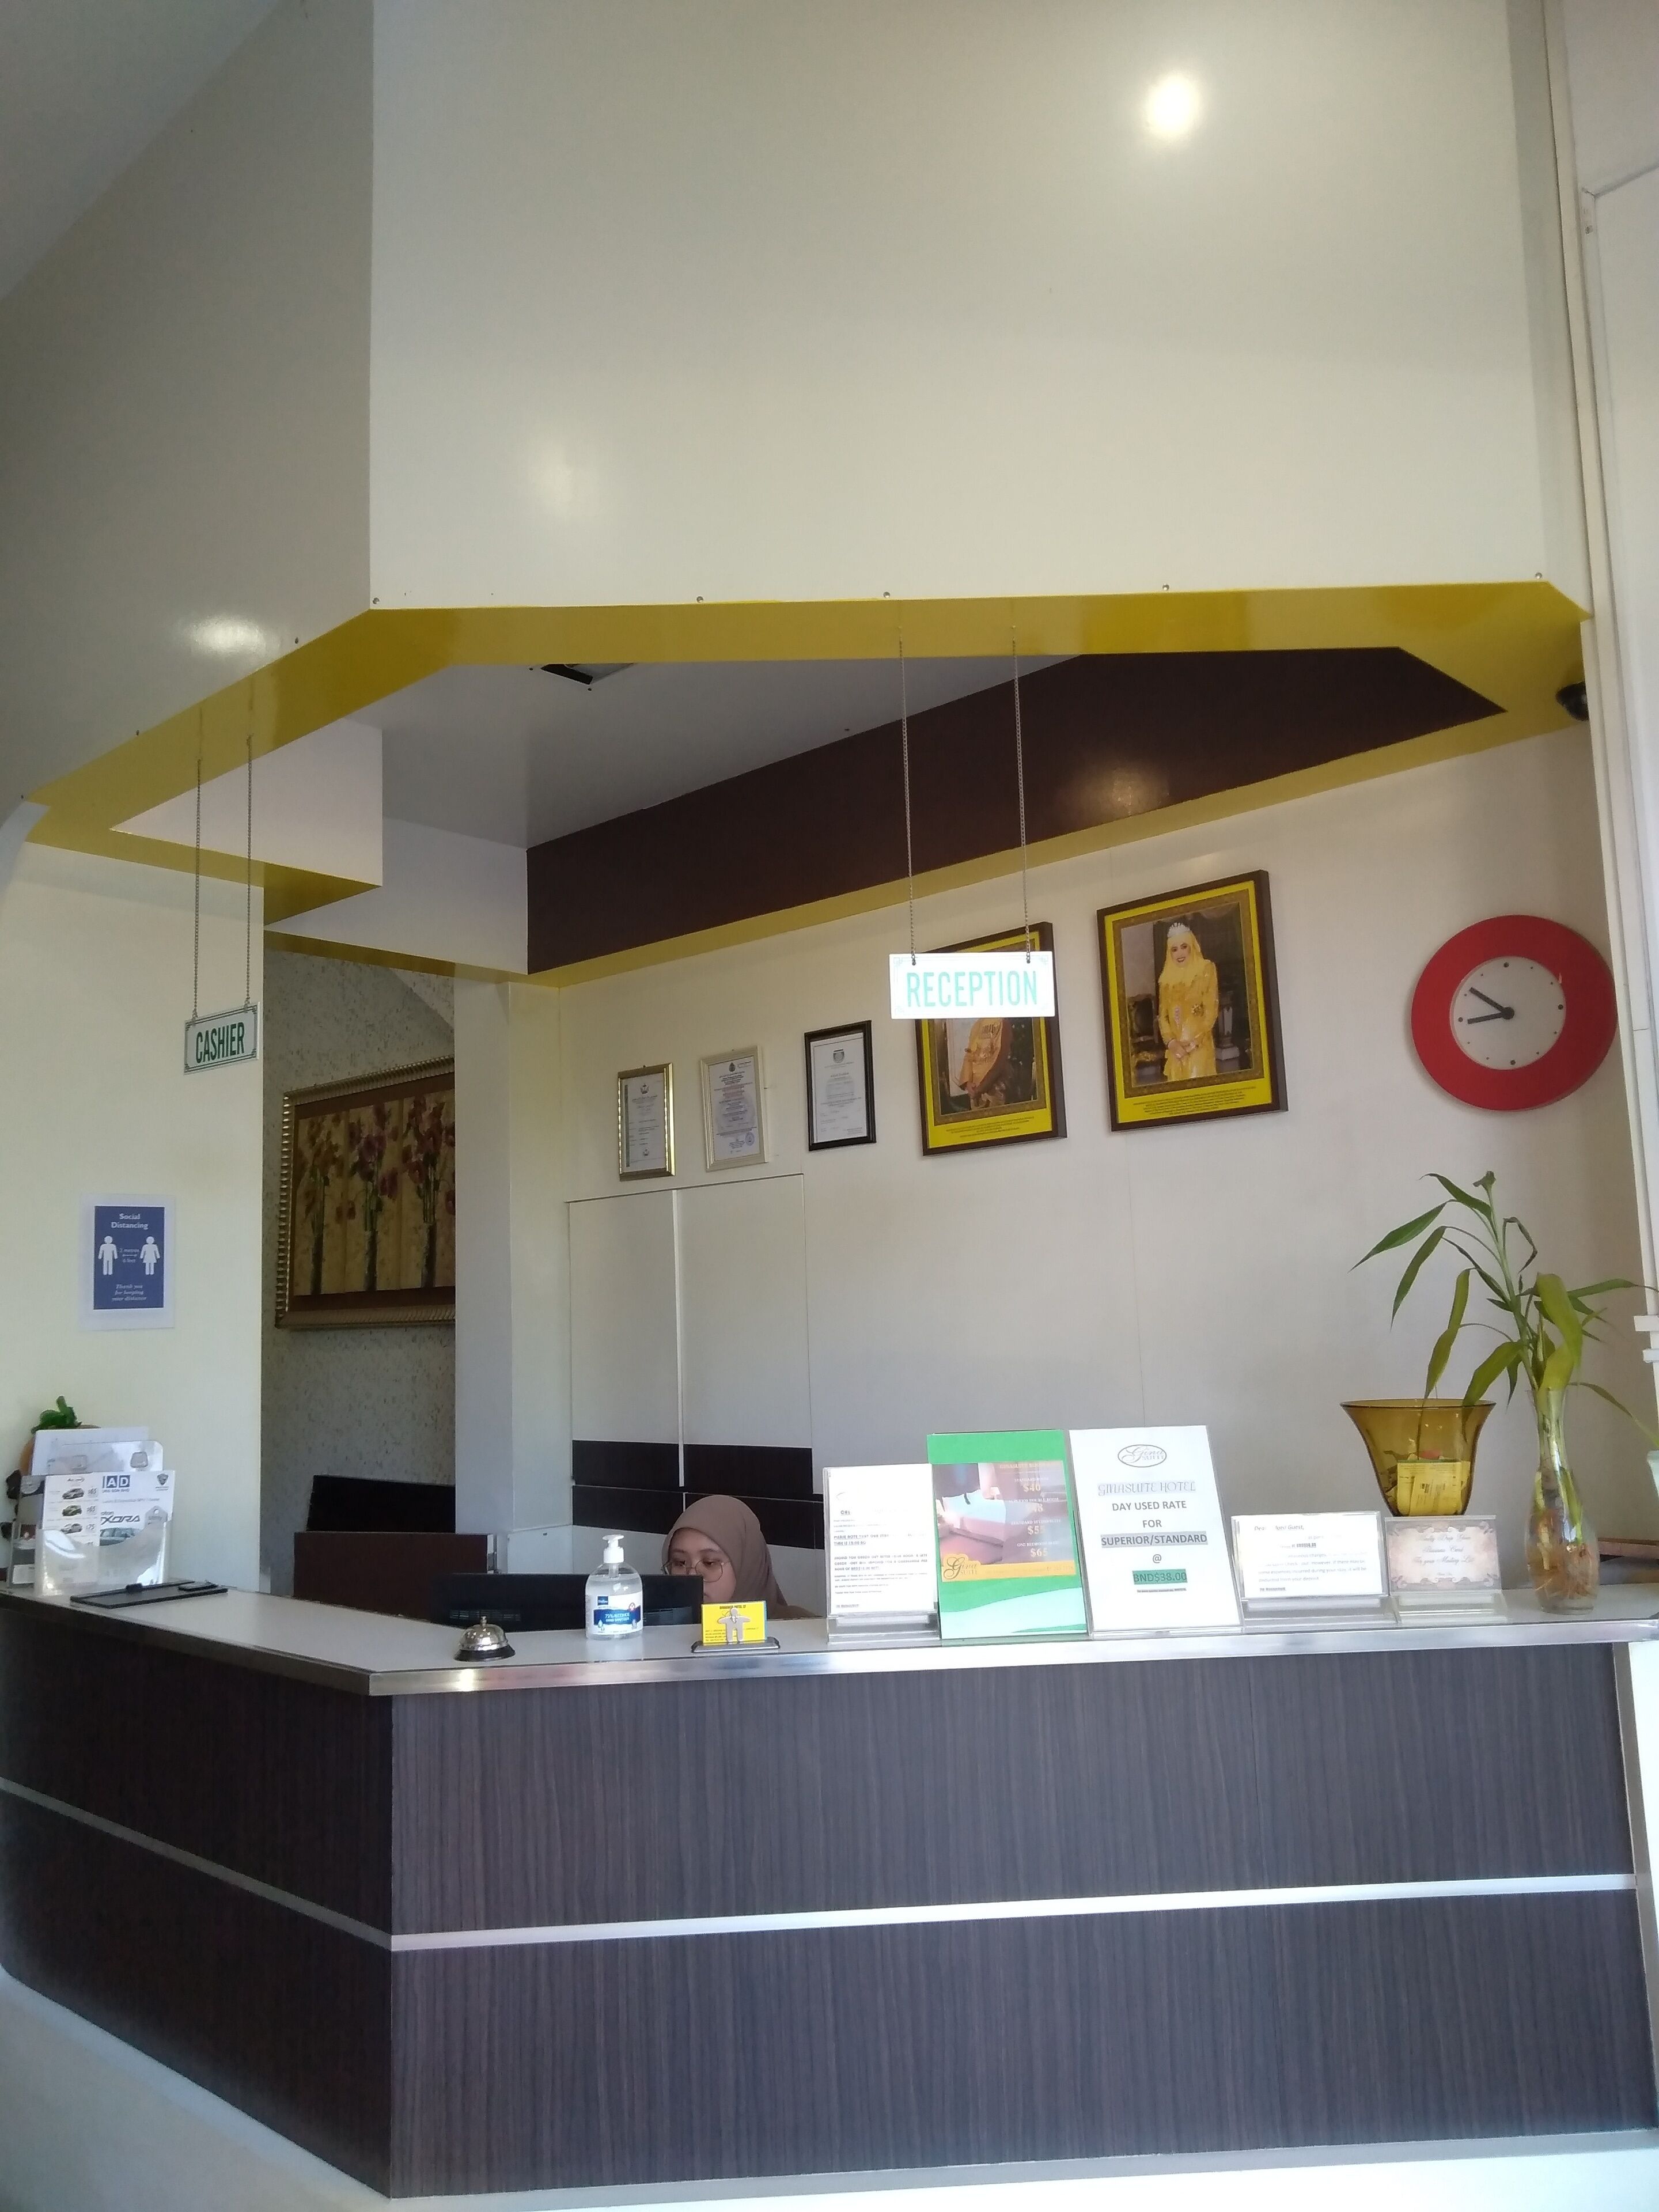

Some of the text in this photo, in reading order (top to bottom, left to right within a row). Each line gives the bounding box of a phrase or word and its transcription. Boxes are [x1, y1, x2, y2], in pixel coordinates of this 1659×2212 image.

[907, 971, 1037, 1007] RECEPTION
[196, 1022, 244, 1063] CASHIER
[111, 1222, 149, 1230] Distancing
[1122, 1446, 1163, 1463] Gina
[1023, 1483, 1041, 1493] $40
[1160, 1481, 1196, 1493] HOTEL
[1112, 1501, 1187, 1511] DAY USED RATE
[1142, 1520, 1162, 1528] FOR
[1101, 1534, 1207, 1546] SUPERIOR/STANDARD
[1030, 1548, 1048, 1558] $65
[1152, 1554, 1162, 1563] @
[944, 1556, 977, 1580] Gina
[1133, 1572, 1187, 1582] BND$38.00
